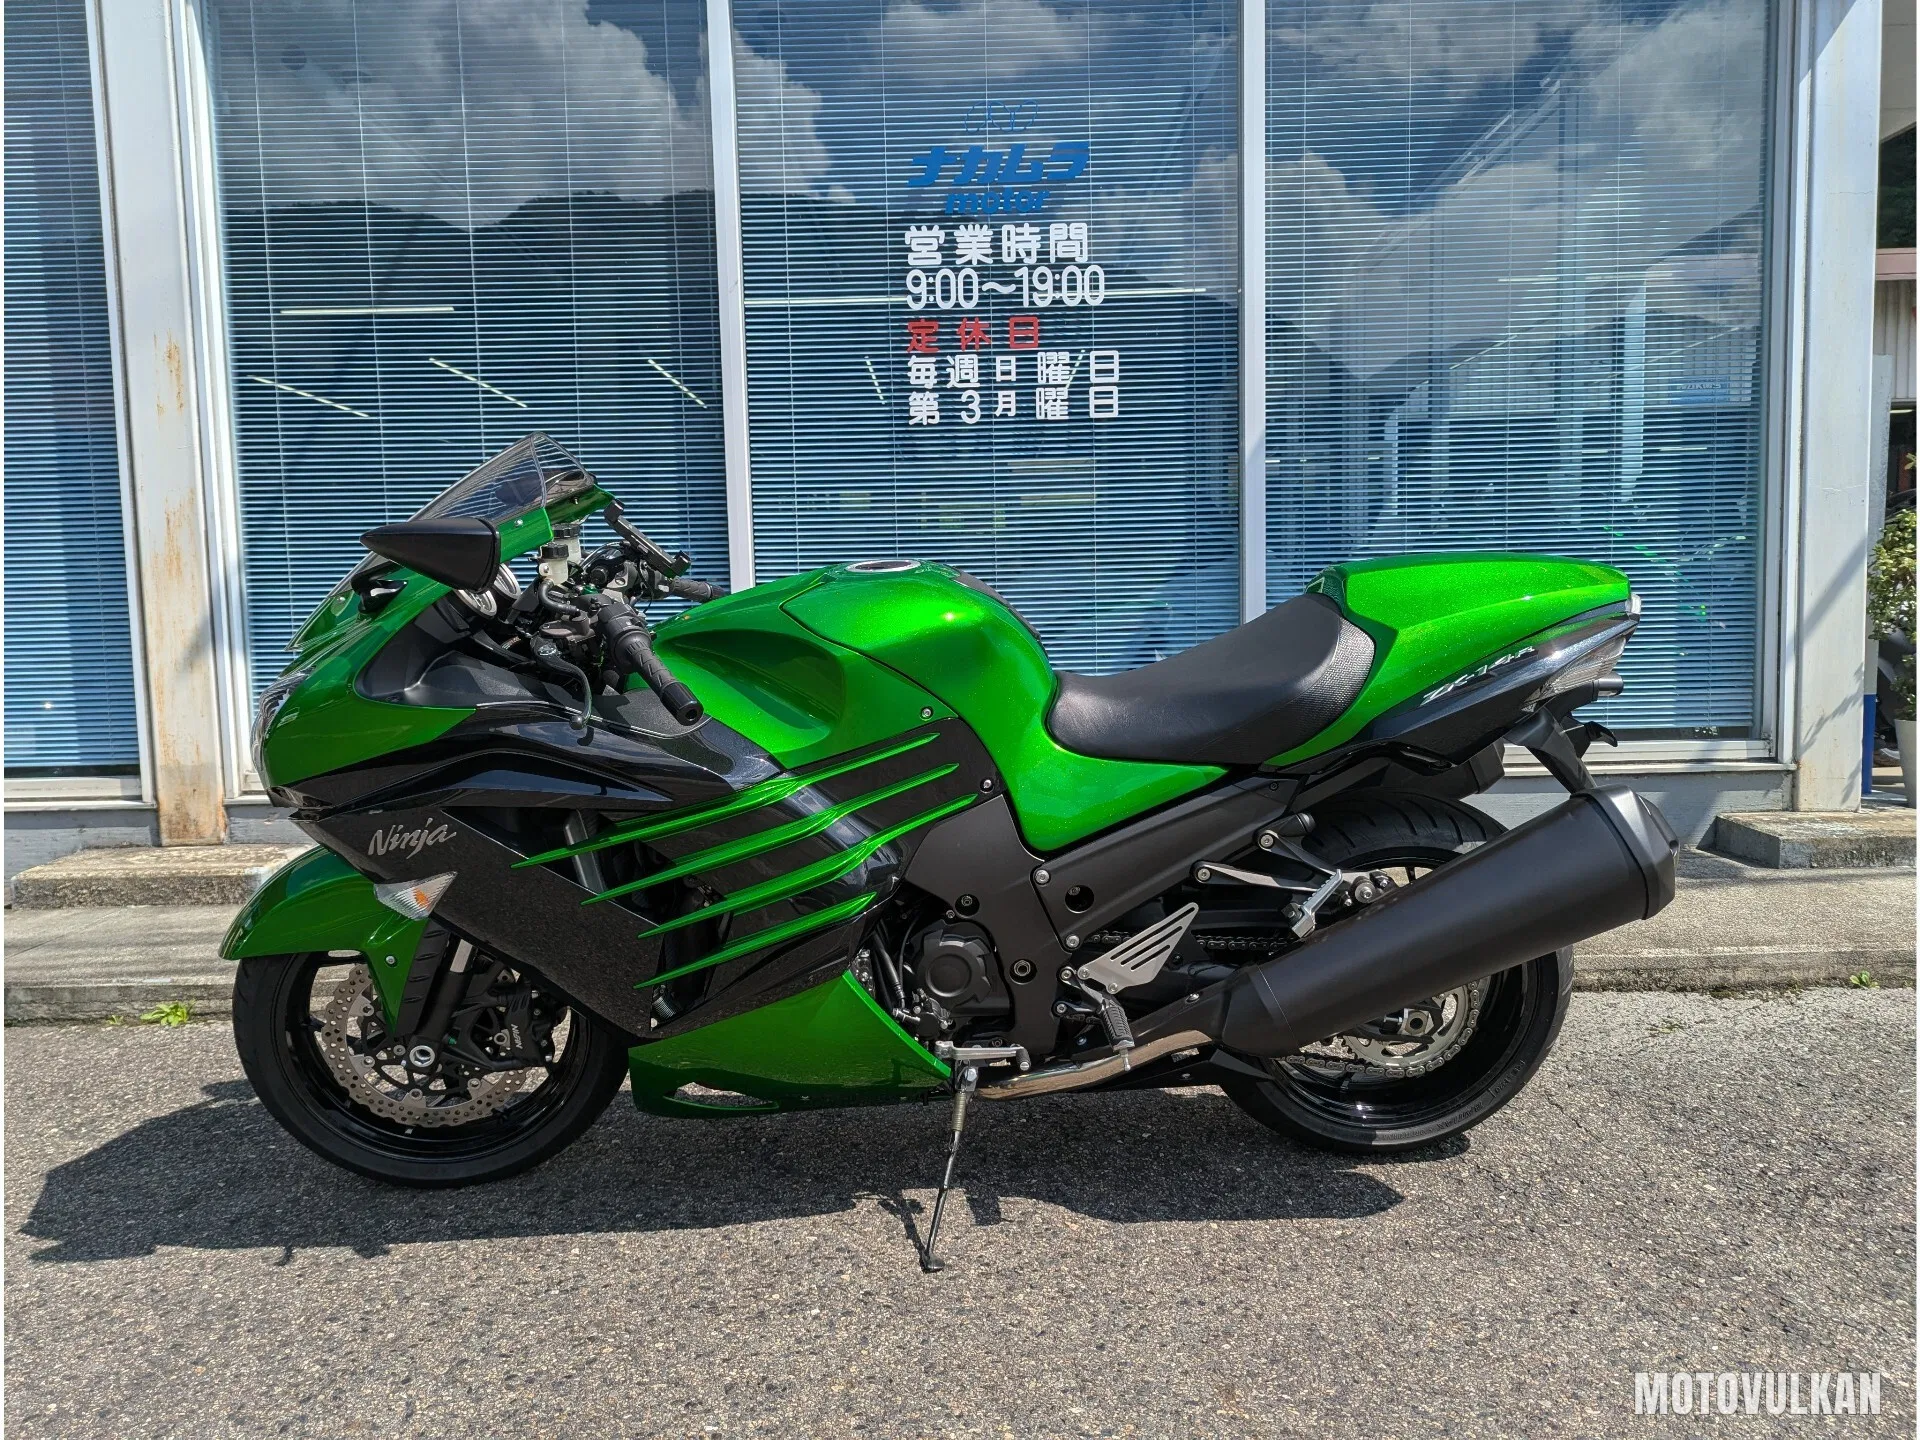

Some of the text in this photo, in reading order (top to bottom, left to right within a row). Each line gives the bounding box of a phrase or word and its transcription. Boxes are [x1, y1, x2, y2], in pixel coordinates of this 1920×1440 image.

[907, 142, 1090, 187] ナカムラ
[945, 186, 1051, 214] motor
[905, 223, 1088, 265] 営業時間
[907, 317, 1039, 351] 定休日
[906, 350, 1119, 388] 毎週日曜日
[908, 386, 1119, 425] 第3月曜日
[367, 817, 457, 860] Ninja
